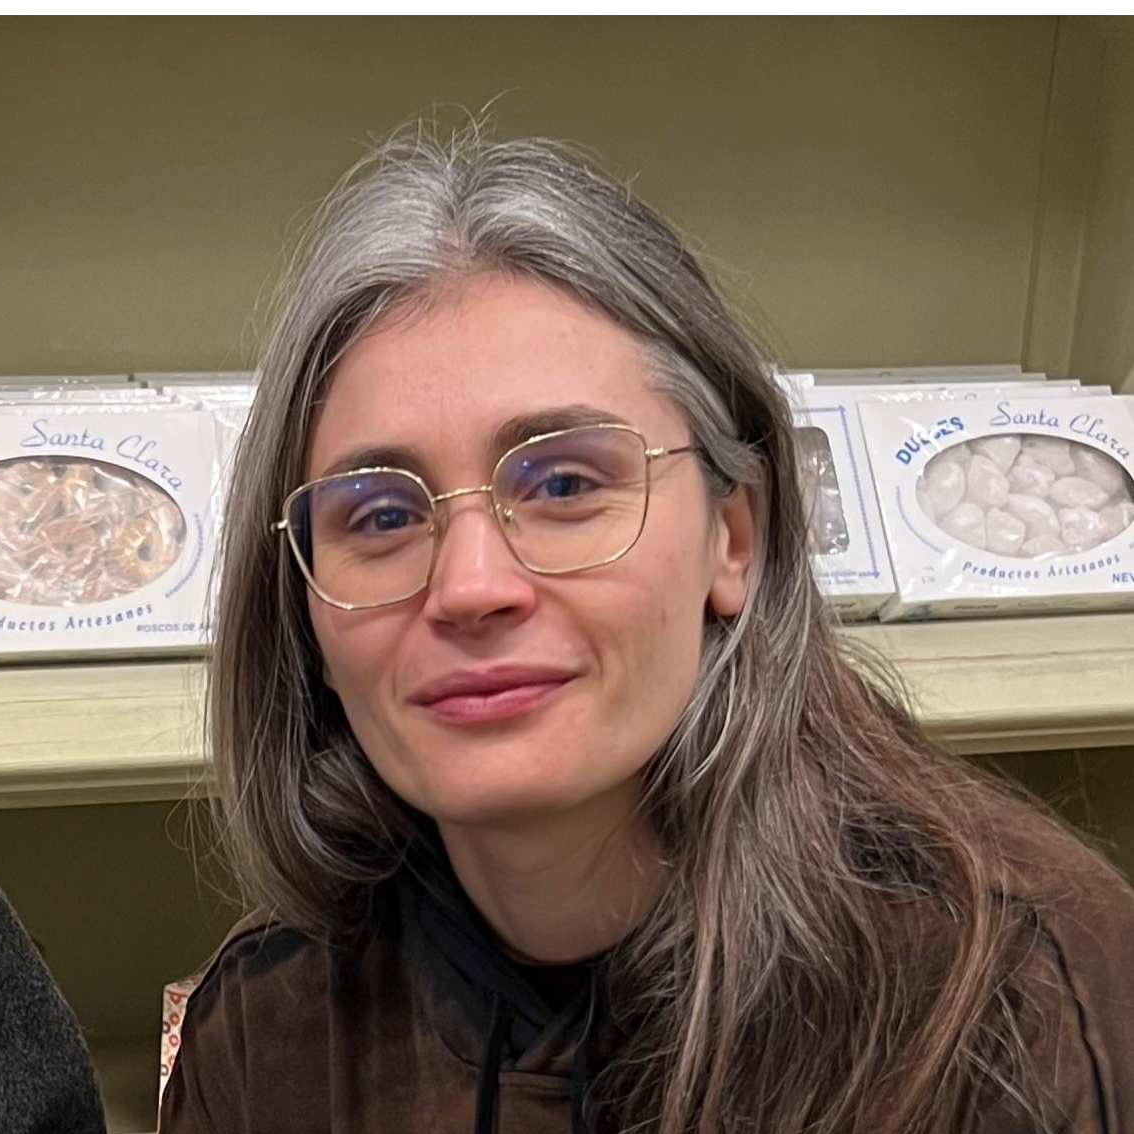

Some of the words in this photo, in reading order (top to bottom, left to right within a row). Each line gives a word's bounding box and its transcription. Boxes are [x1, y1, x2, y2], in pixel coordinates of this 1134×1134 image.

[989, 401, 1060, 428] Santa
[1069, 414, 1130, 460] Clara
[20, 418, 105, 451] Santa
[116, 434, 184, 491] Clara
[961, 560, 1040, 579] Productos
[1047, 553, 1120, 578] Artesanos
[64, 602, 153, 630] Artesanos
